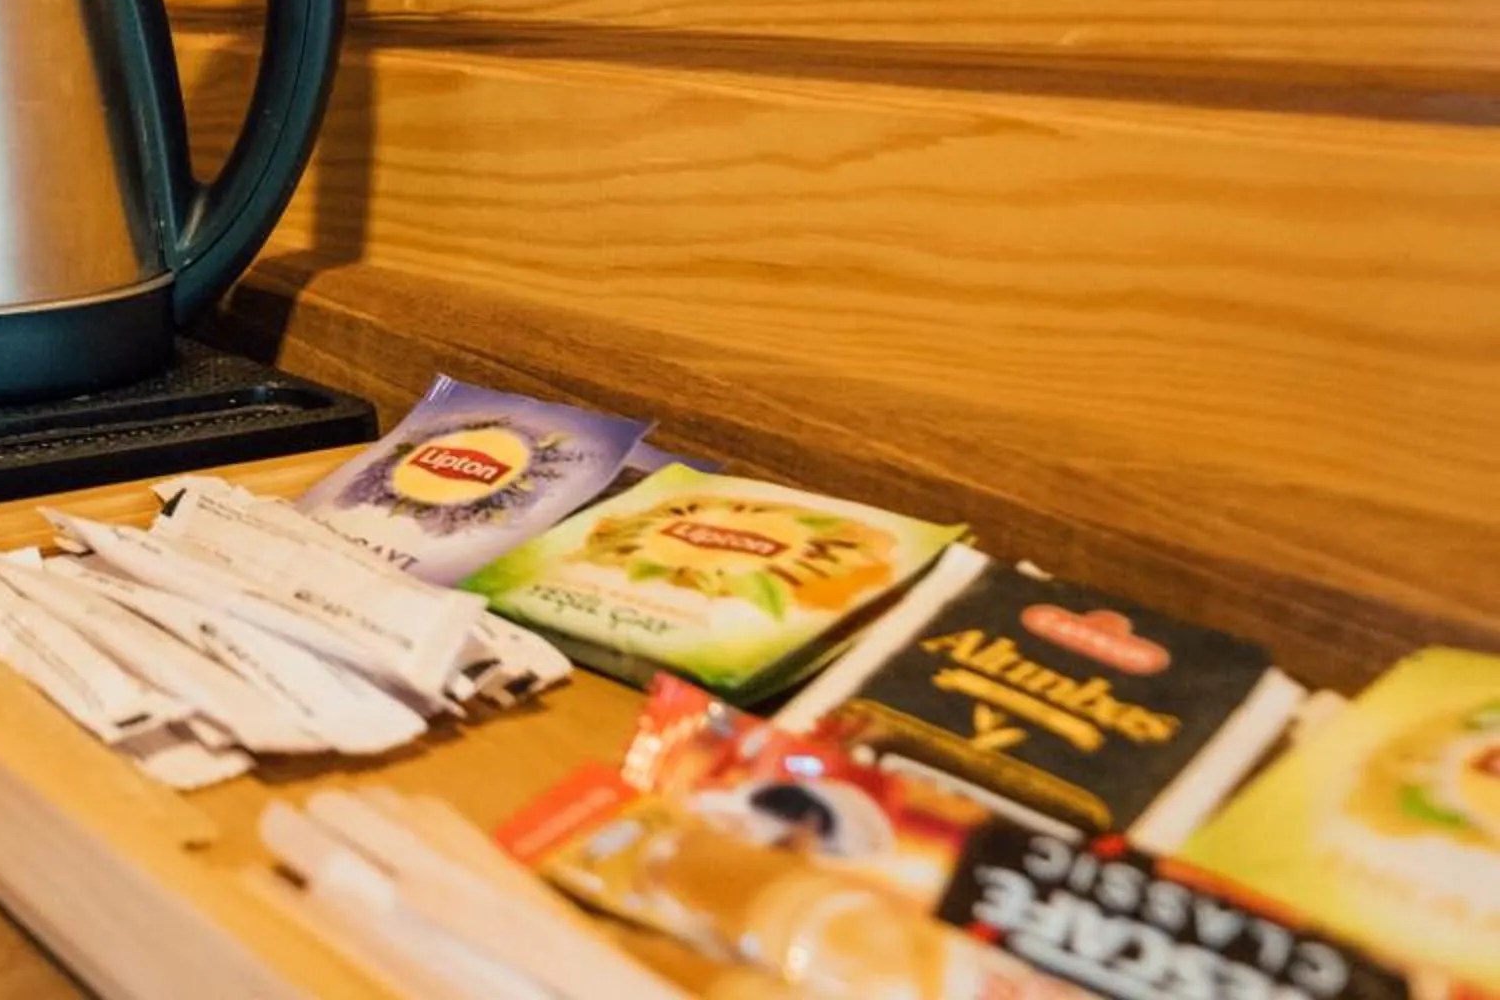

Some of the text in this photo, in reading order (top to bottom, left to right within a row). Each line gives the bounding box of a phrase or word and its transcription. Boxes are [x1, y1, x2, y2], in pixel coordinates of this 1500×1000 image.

[418, 448, 499, 481] Lipton
[671, 523, 777, 555] Lipton
[1022, 834, 1350, 999] CLASSIC
